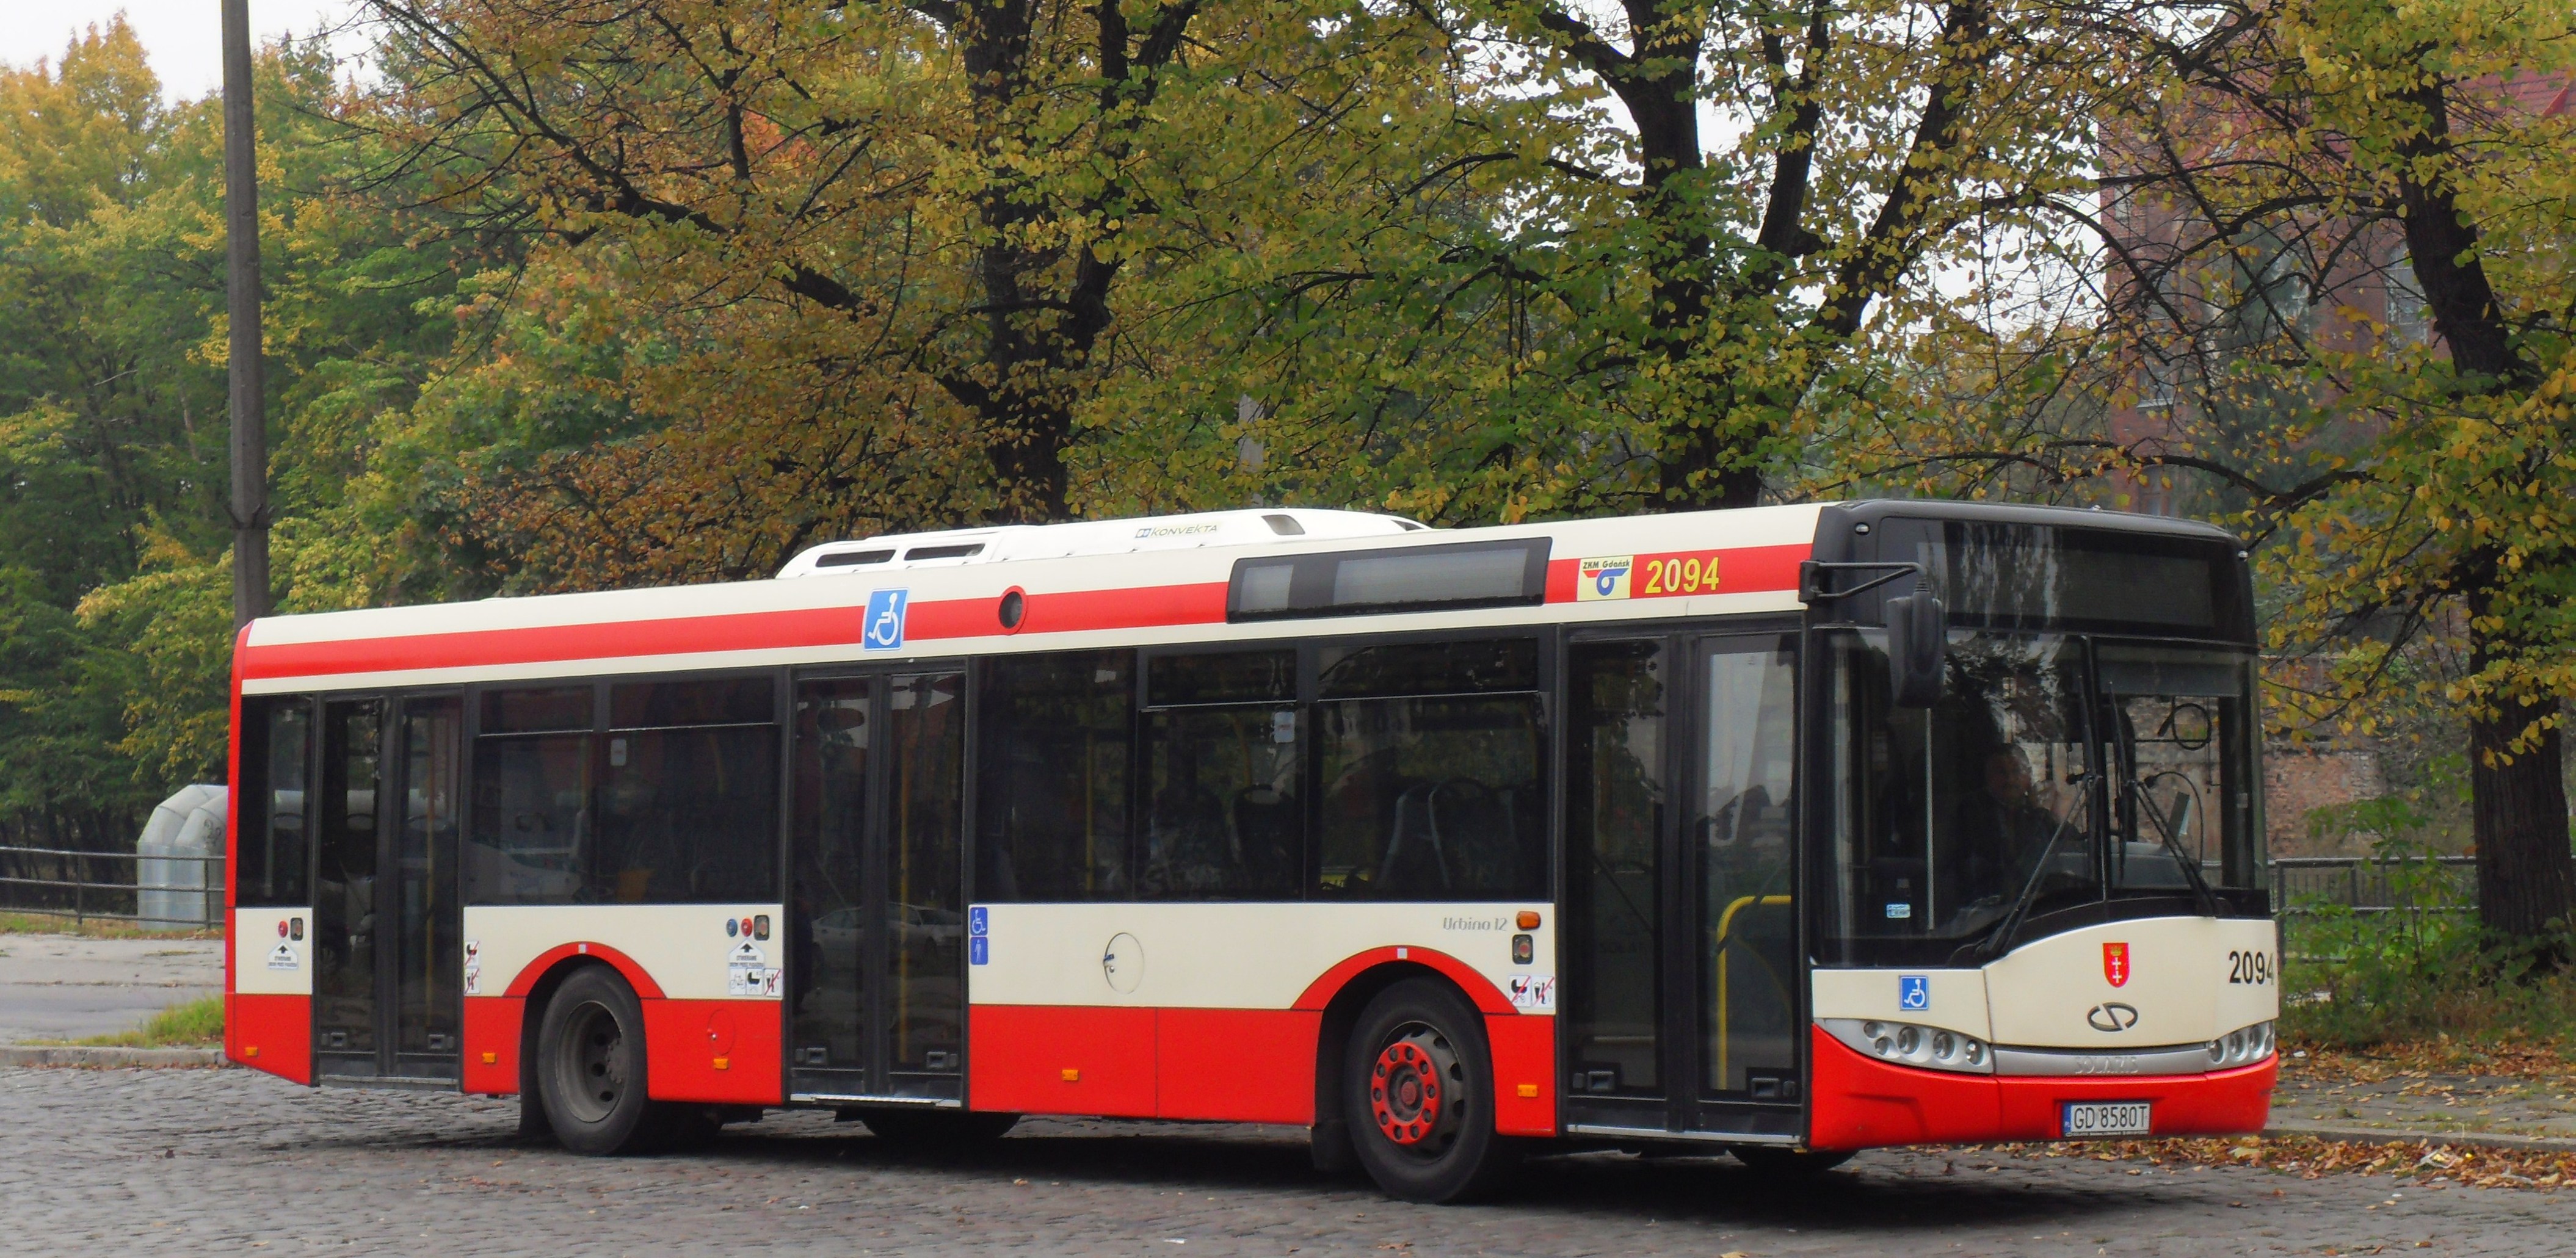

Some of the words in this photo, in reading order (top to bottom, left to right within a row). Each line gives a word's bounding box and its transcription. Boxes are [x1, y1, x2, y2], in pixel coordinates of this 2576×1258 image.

[1150, 525, 1218, 537] KONVEKTA
[1583, 561, 1600, 569] ZKM
[1602, 559, 1630, 568] Gdańsk
[1644, 556, 1720, 594] 2094
[1443, 917, 1491, 931] Urbino
[1493, 917, 1508, 931] 12
[2229, 950, 2274, 986] 2094
[2074, 1107, 2095, 1129] GD
[2100, 1105, 2147, 1128] 8580T
